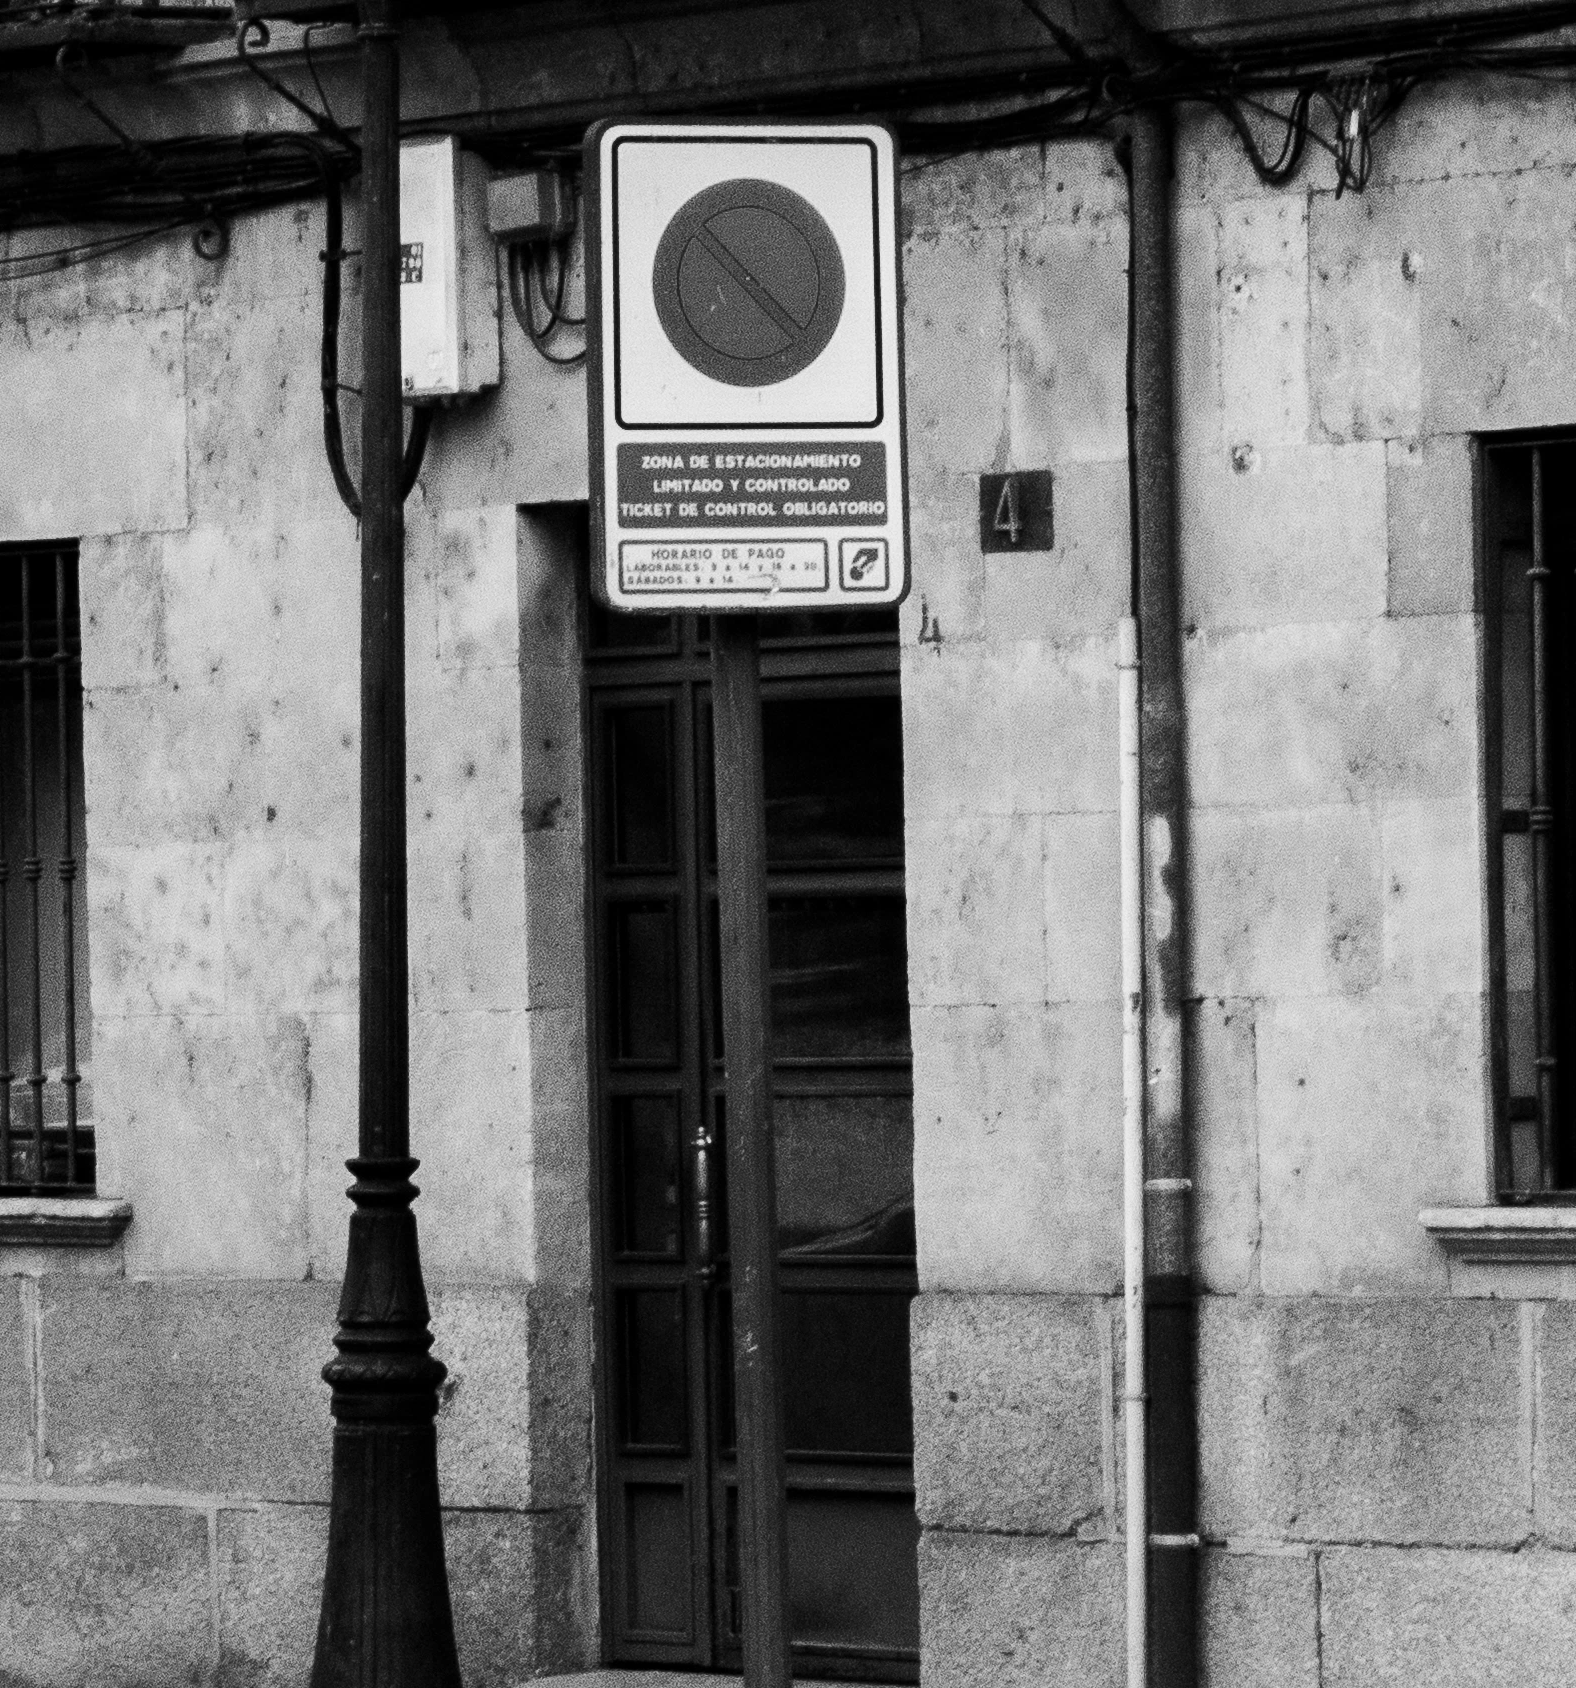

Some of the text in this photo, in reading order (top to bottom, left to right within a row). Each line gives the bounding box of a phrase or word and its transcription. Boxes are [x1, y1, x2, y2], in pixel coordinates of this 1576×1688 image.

[641, 453, 861, 469] ZONA DE ESTACIONAMIENTO
[653, 477, 850, 493] LIMITADO Y CONTROLADO
[620, 500, 885, 517] TICKET DE CONTROL OBLIGATORIO
[994, 477, 1022, 542] 4
[651, 547, 785, 560] HORARIO DE PAGO
